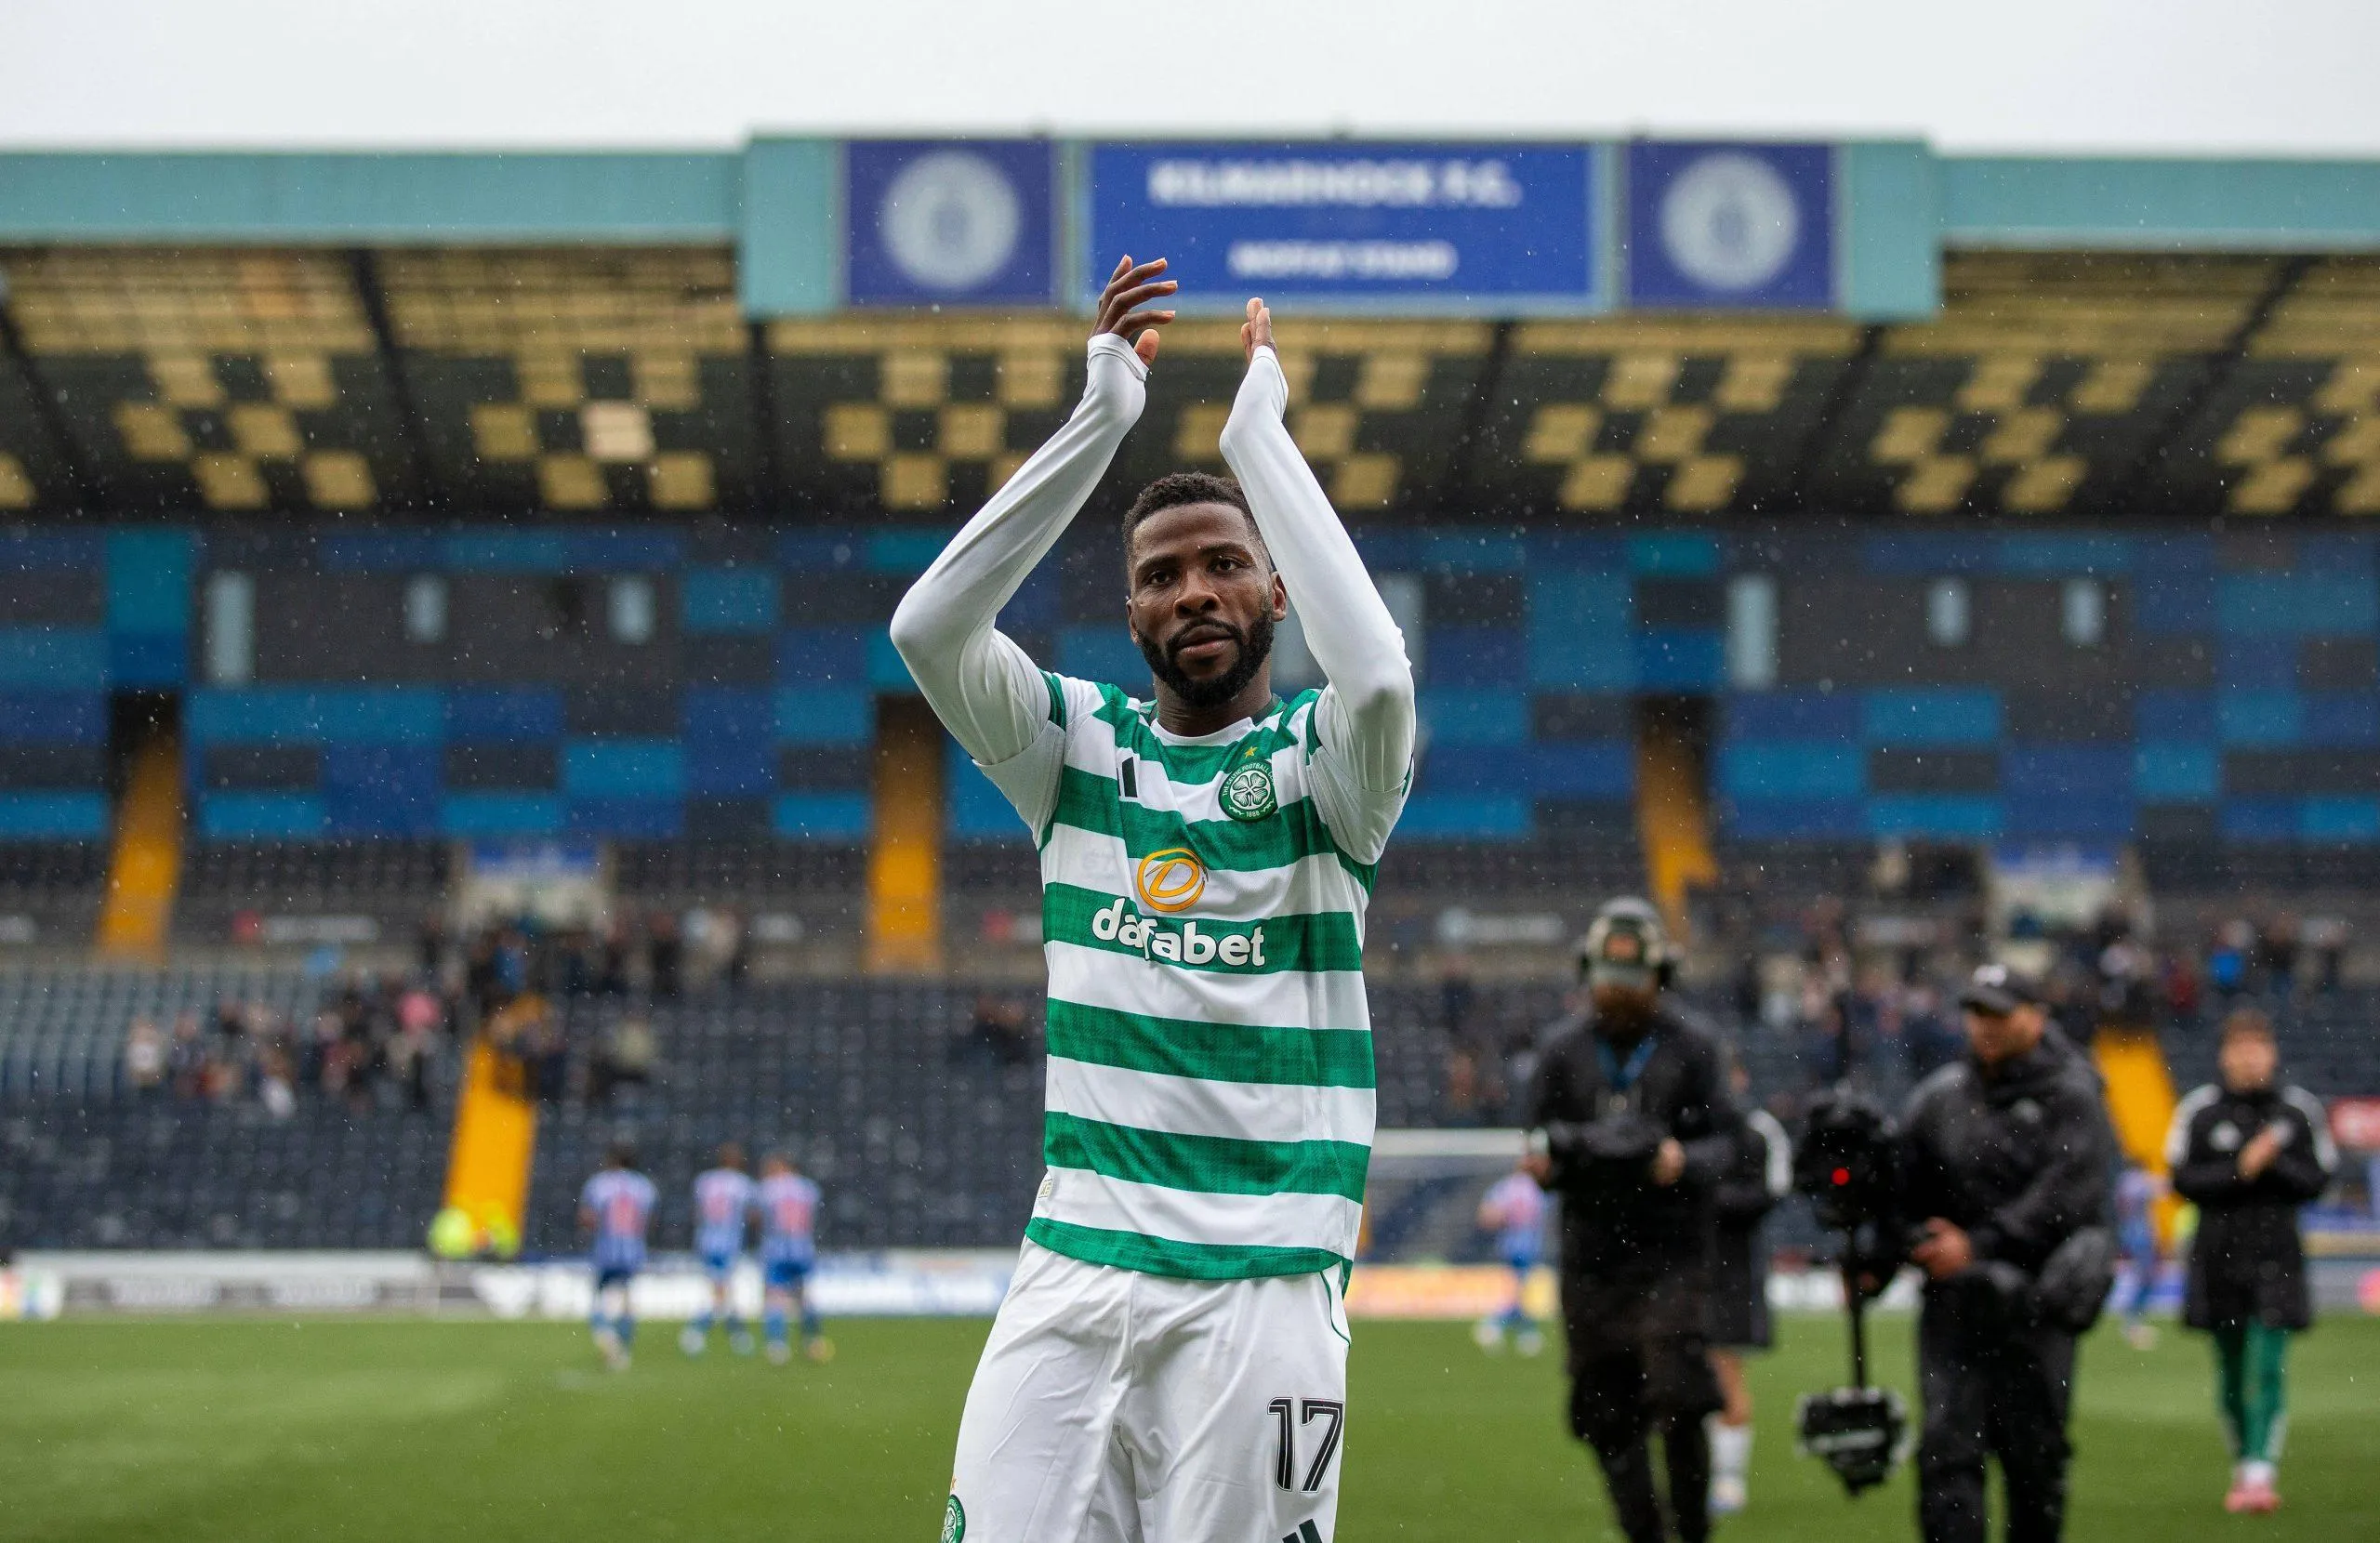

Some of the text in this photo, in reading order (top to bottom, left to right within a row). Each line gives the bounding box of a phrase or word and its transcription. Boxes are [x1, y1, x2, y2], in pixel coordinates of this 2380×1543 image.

[1226, 769, 1242, 785] CELTIC
[1242, 762, 1269, 773] FOOTBALL
[1091, 896, 1265, 967] dafabet
[1267, 1397, 1344, 1493] 17
